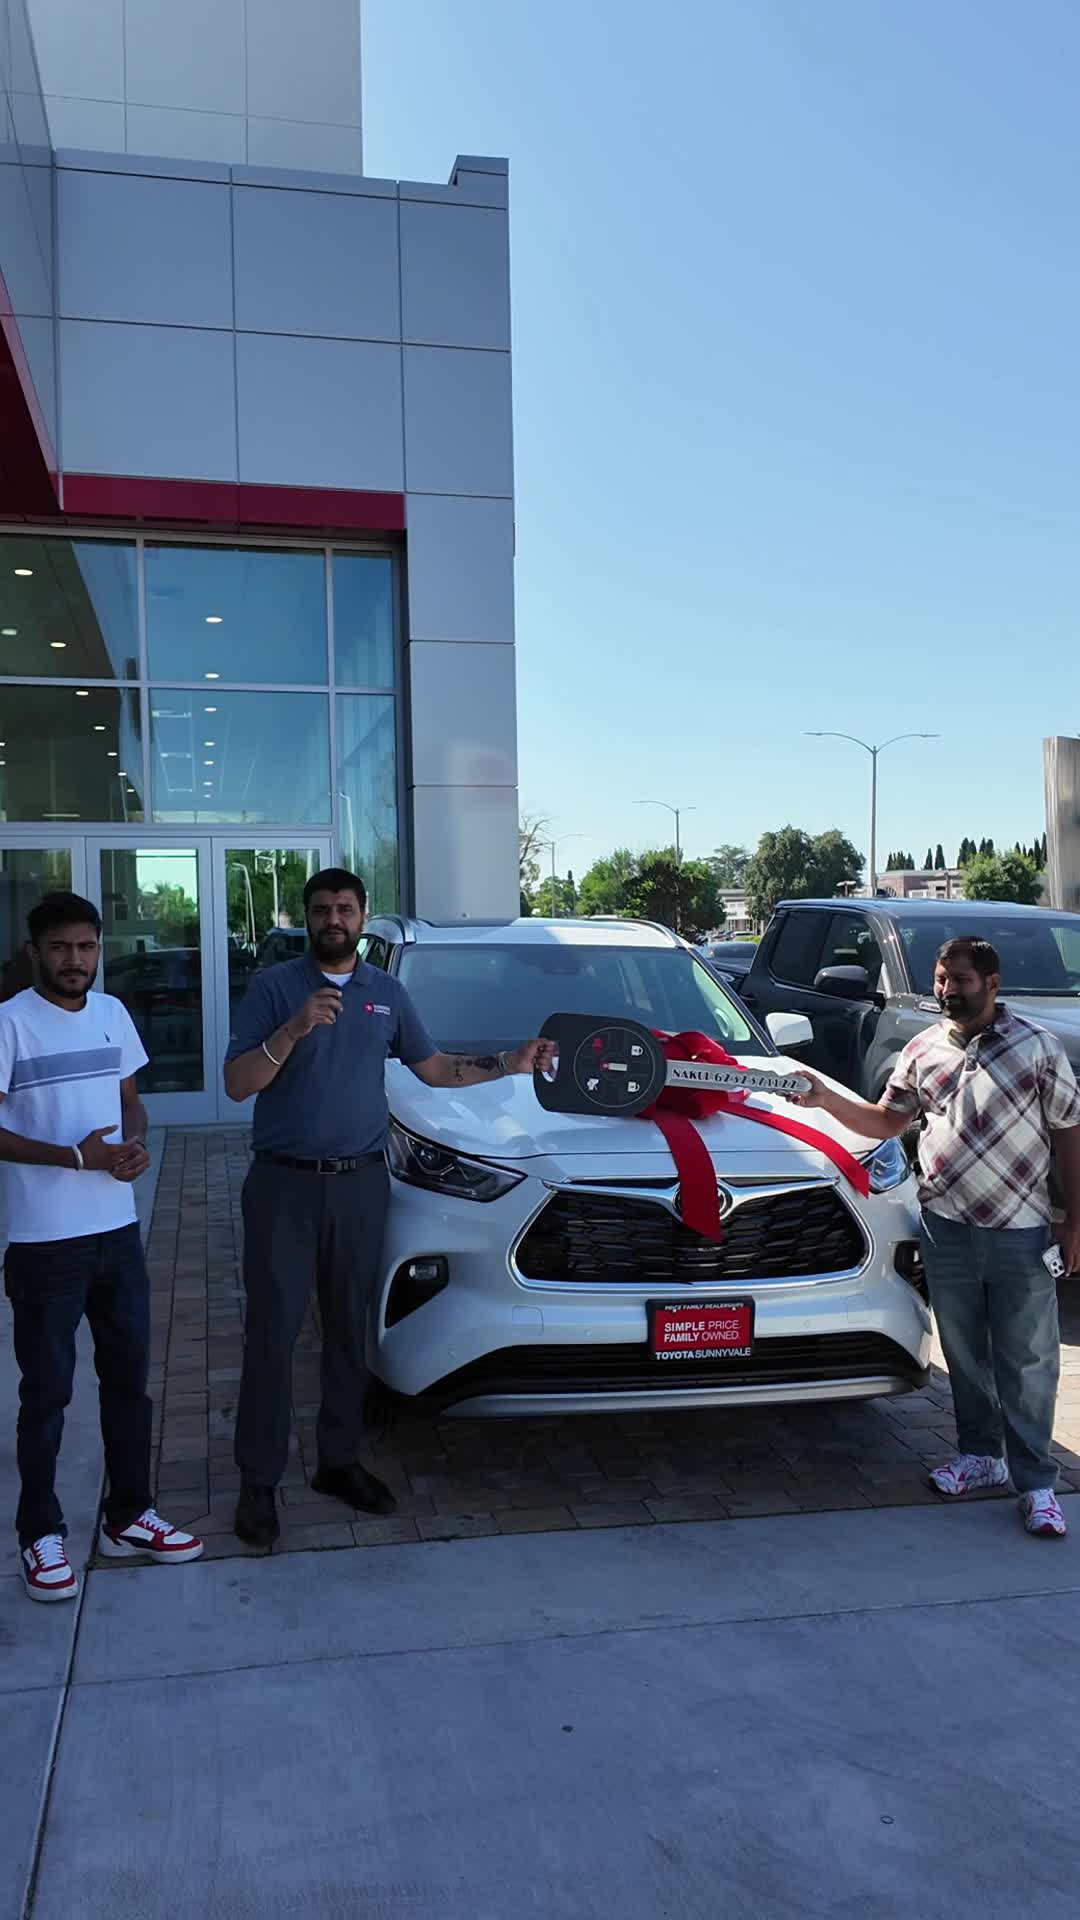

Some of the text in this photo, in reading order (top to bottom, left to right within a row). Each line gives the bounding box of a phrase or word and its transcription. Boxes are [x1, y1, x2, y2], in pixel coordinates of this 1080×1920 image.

[664, 1321, 705, 1332] SIMPLE
[664, 1332, 700, 1343] FAMILY
[655, 1347, 751, 1360] TOYOTA SUNNYVALE
